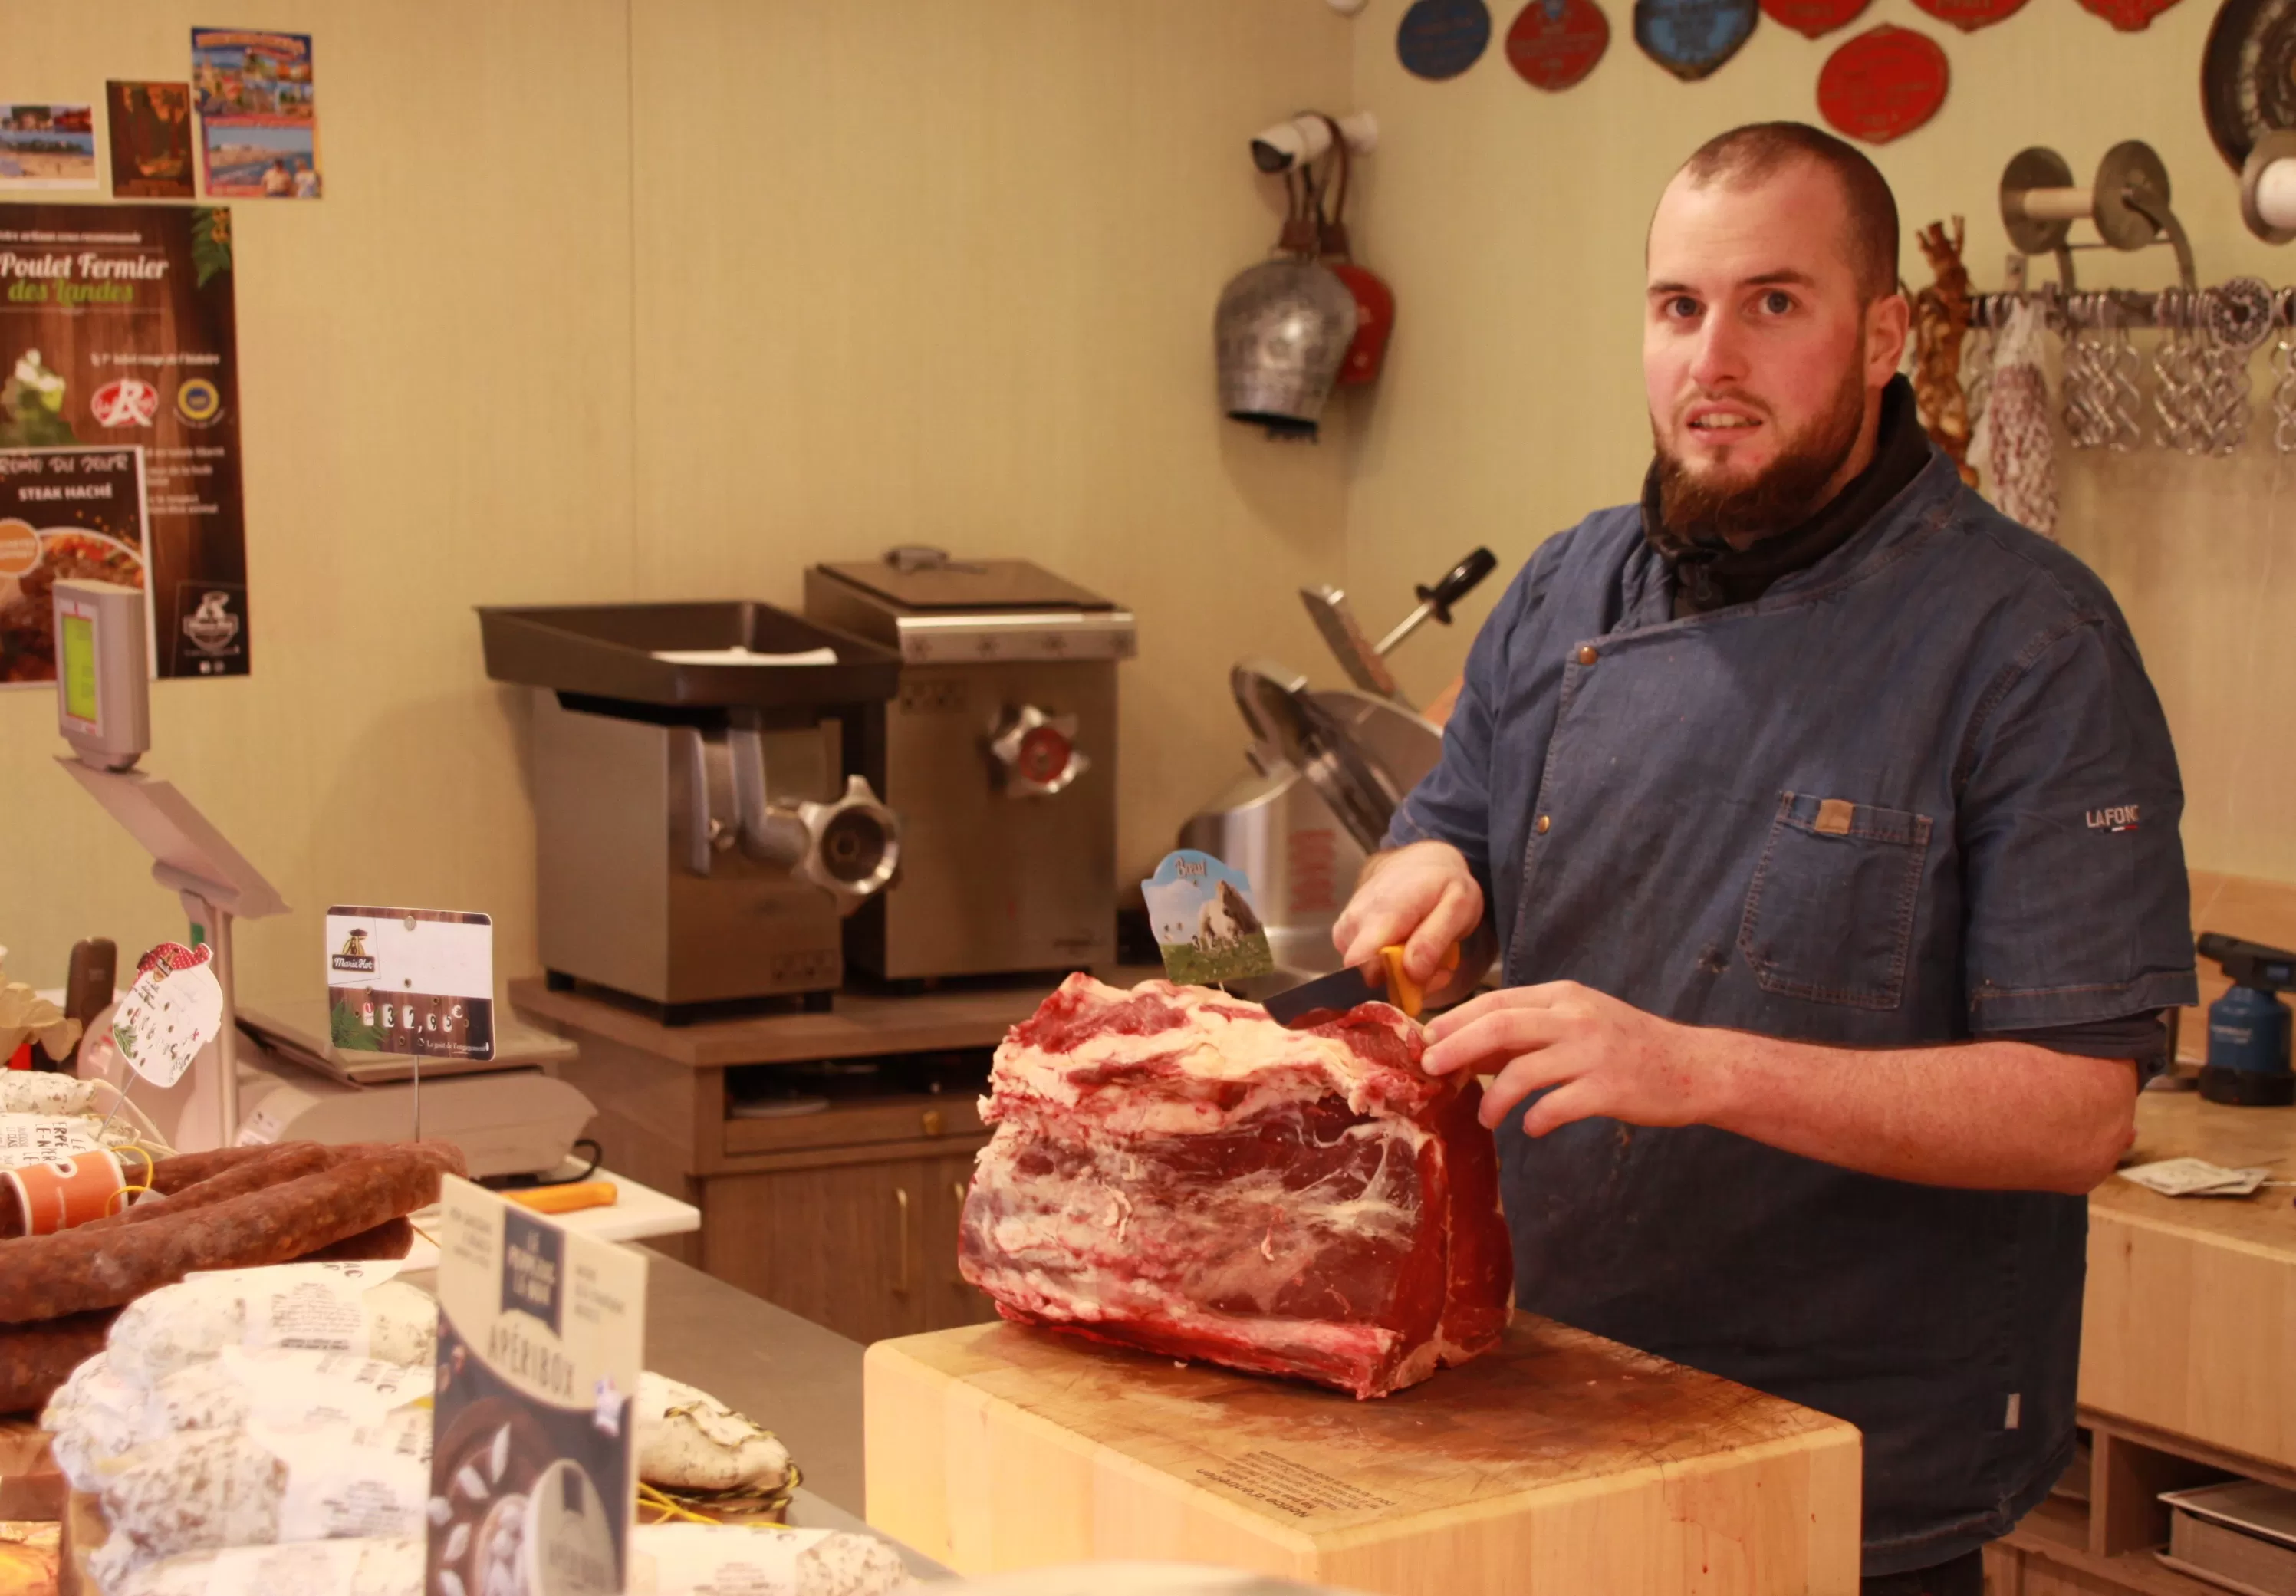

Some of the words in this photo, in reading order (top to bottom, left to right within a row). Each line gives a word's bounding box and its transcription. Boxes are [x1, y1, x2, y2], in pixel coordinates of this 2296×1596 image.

[0, 252, 73, 278] Poulet
[77, 252, 169, 279] Fermier
[8, 277, 48, 301] des
[53, 276, 133, 308] Landes
[18, 485, 62, 502] STEAK
[64, 482, 113, 499] HACHÉ
[334, 957, 358, 969] Marie
